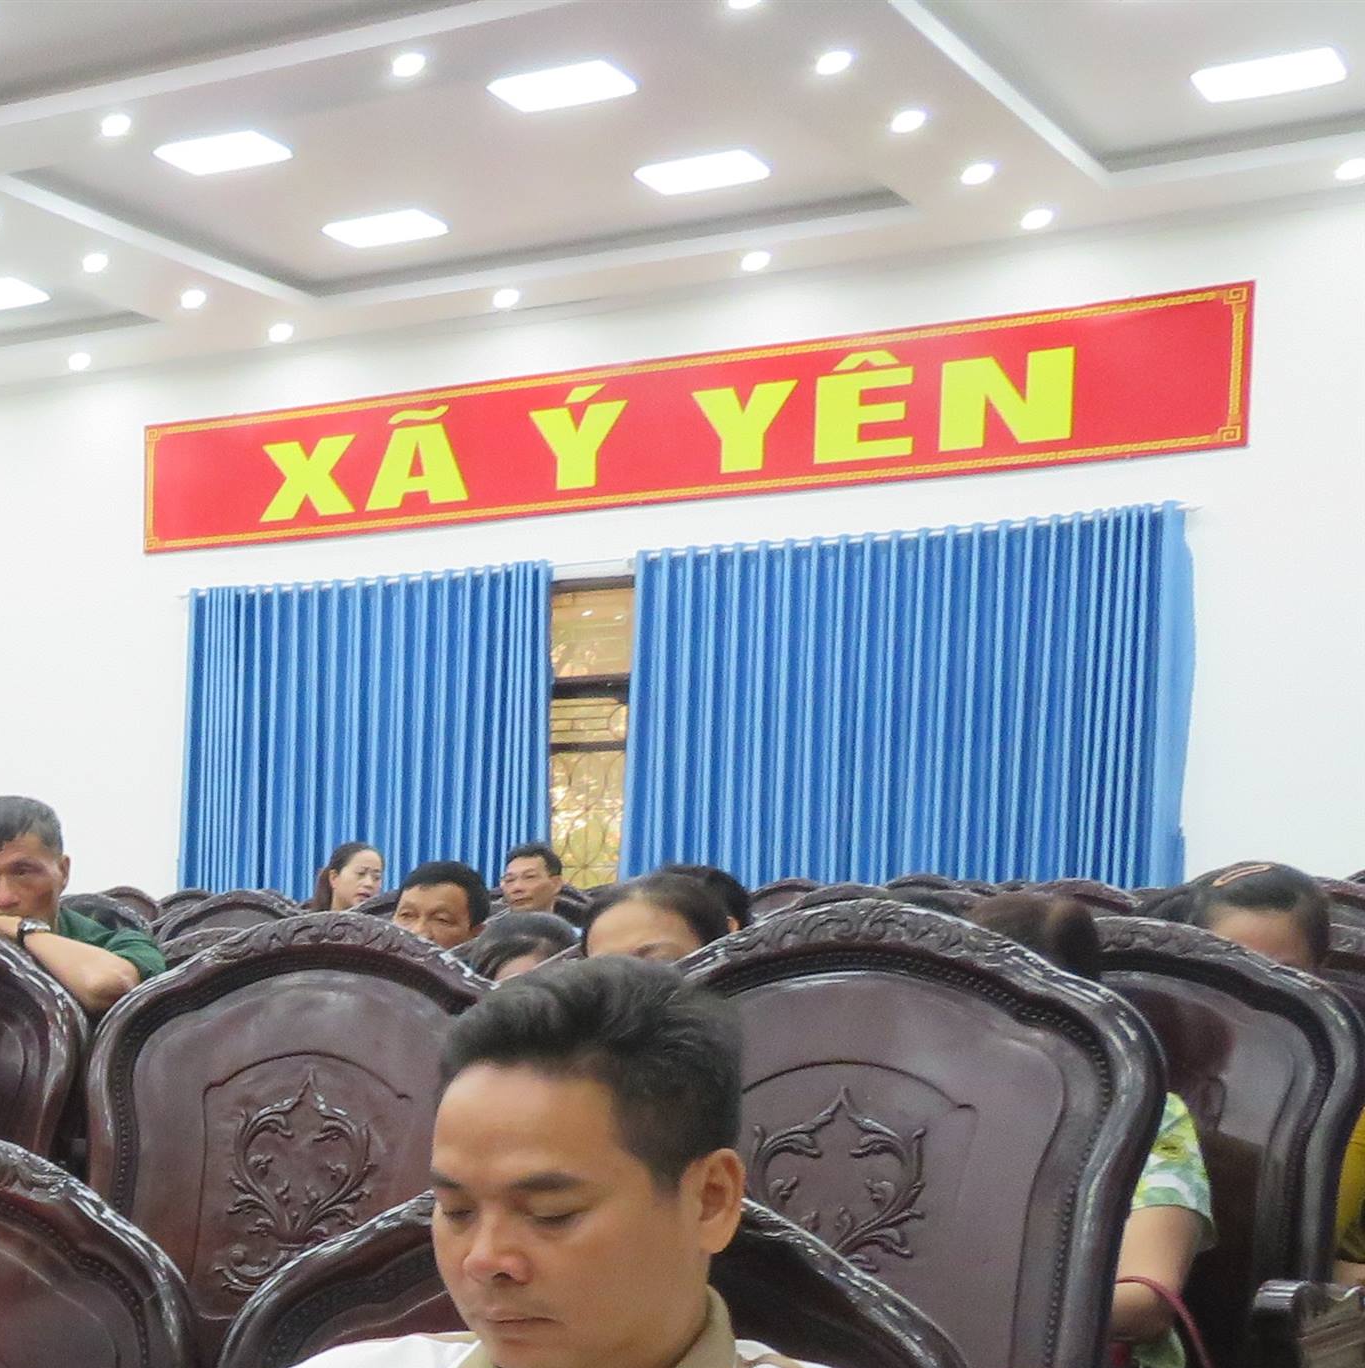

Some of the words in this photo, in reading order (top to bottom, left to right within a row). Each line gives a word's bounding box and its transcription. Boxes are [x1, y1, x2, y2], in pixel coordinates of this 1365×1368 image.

[261, 405, 469, 522] XÃ
[529, 383, 626, 490] Ý
[693, 346, 1075, 473] YÊN
